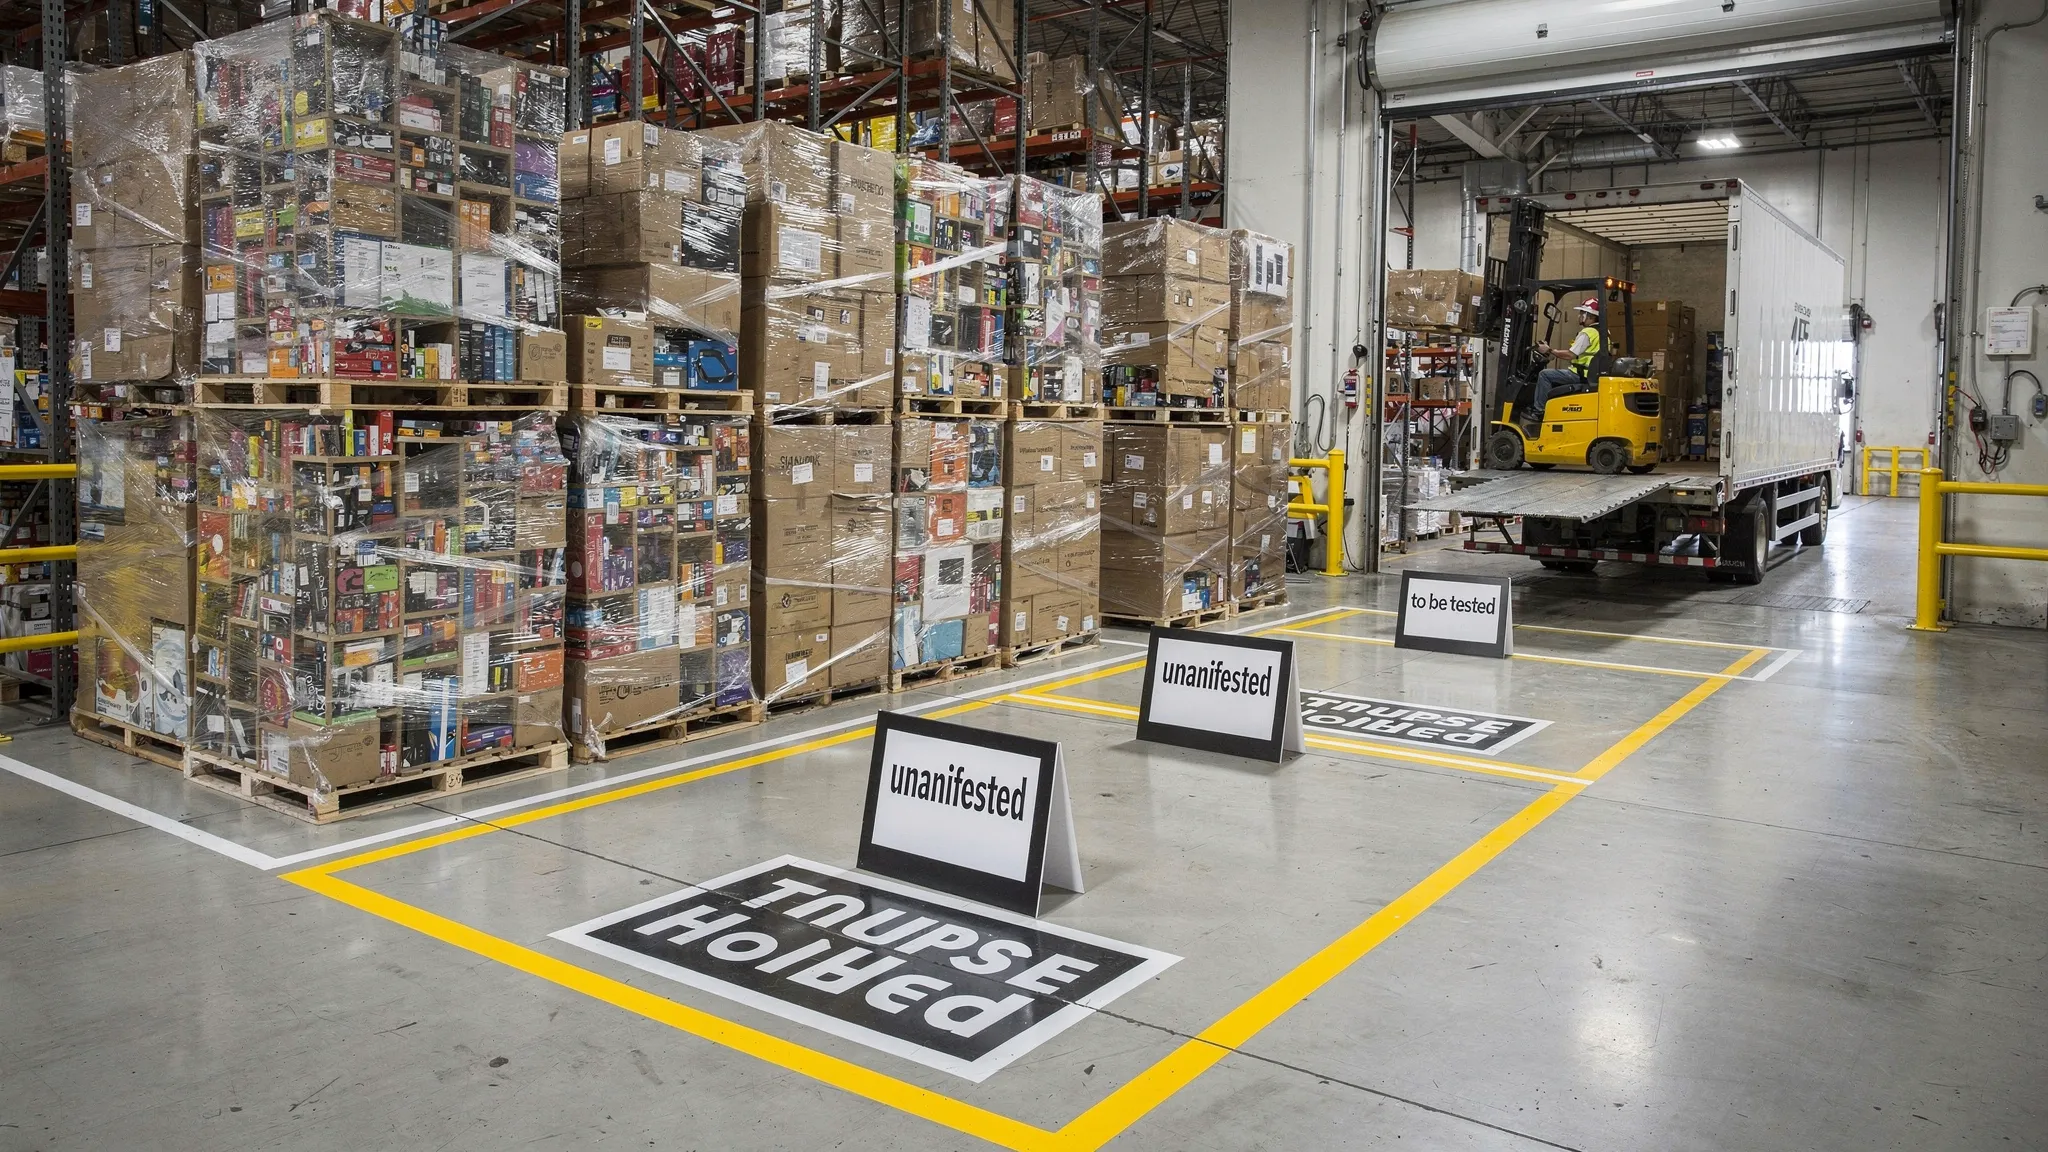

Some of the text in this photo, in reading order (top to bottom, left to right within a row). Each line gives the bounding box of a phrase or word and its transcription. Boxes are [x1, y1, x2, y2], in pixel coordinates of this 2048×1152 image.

[1411, 593, 1496, 614] to be tested
[1162, 660, 1272, 697] unanifested
[890, 764, 1028, 821] unanifested
